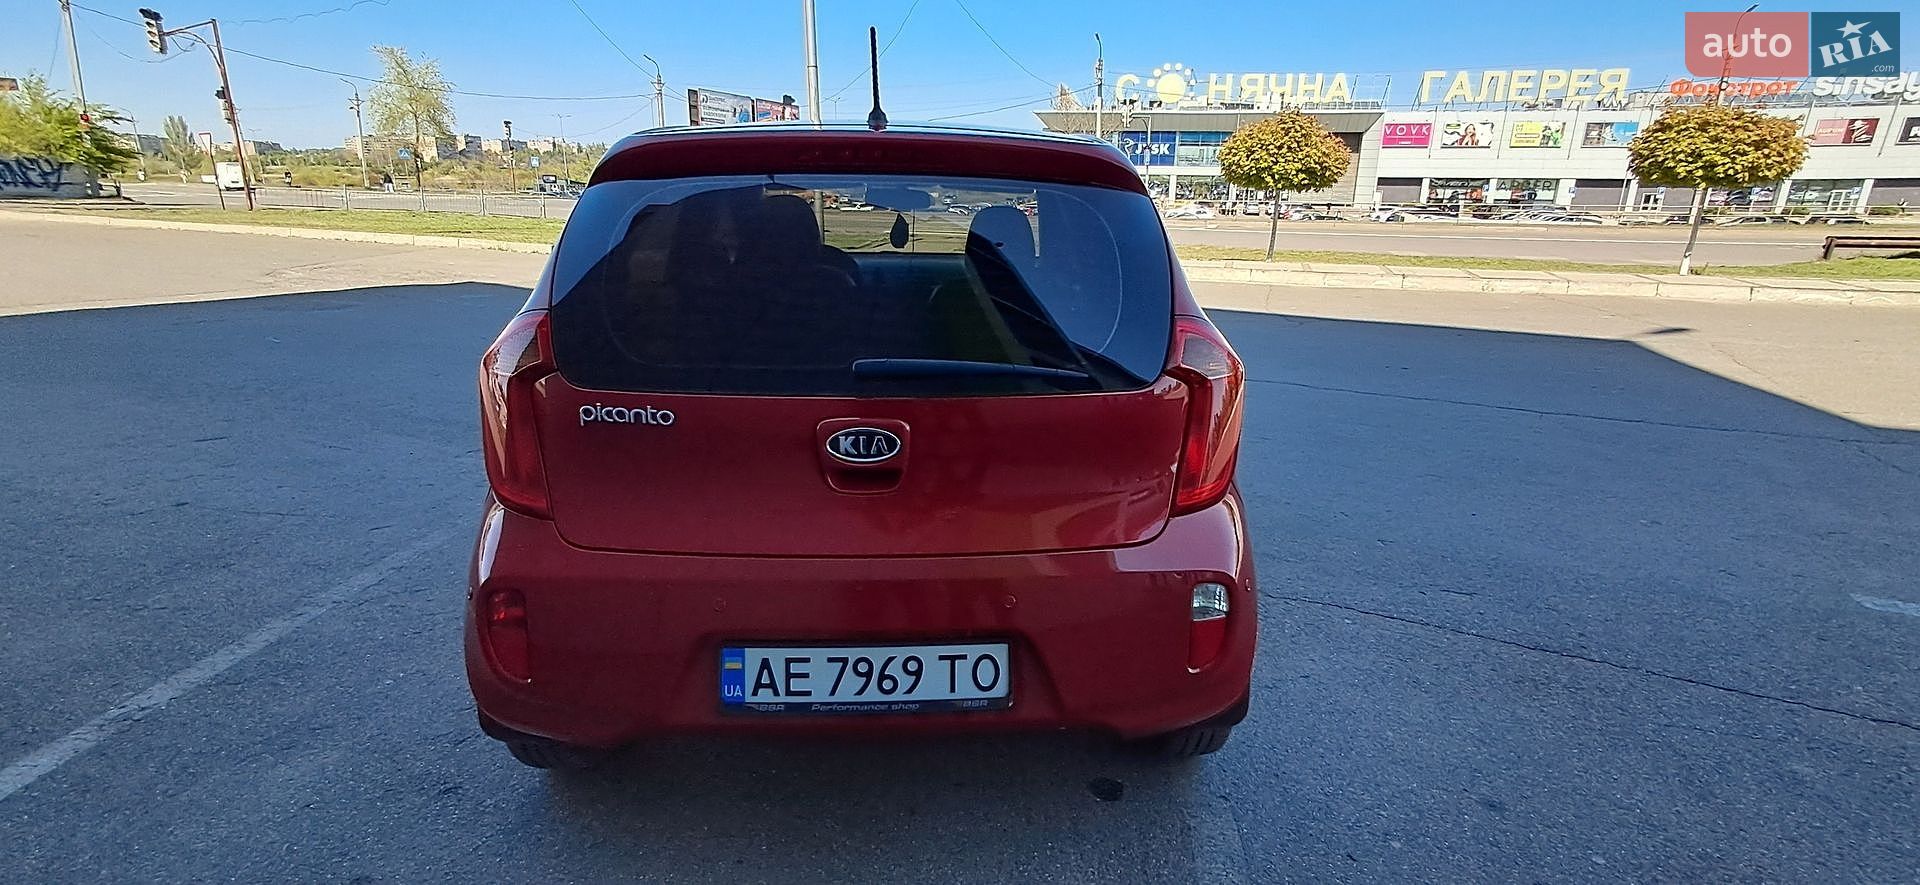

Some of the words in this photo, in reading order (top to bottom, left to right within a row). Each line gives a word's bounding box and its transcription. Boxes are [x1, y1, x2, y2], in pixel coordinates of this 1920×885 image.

[1421, 68, 1630, 103] ГАЛЕРЕЯ
[1384, 125, 1430, 136] VOVK
[579, 403, 675, 427] picanto
[838, 435, 890, 455] KIA
[751, 657, 812, 697] AE
[826, 655, 924, 697] 7969
[938, 653, 1001, 693] TO
[724, 685, 743, 697] UA
[811, 703, 888, 712] Performance
[890, 702, 919, 711] shop
